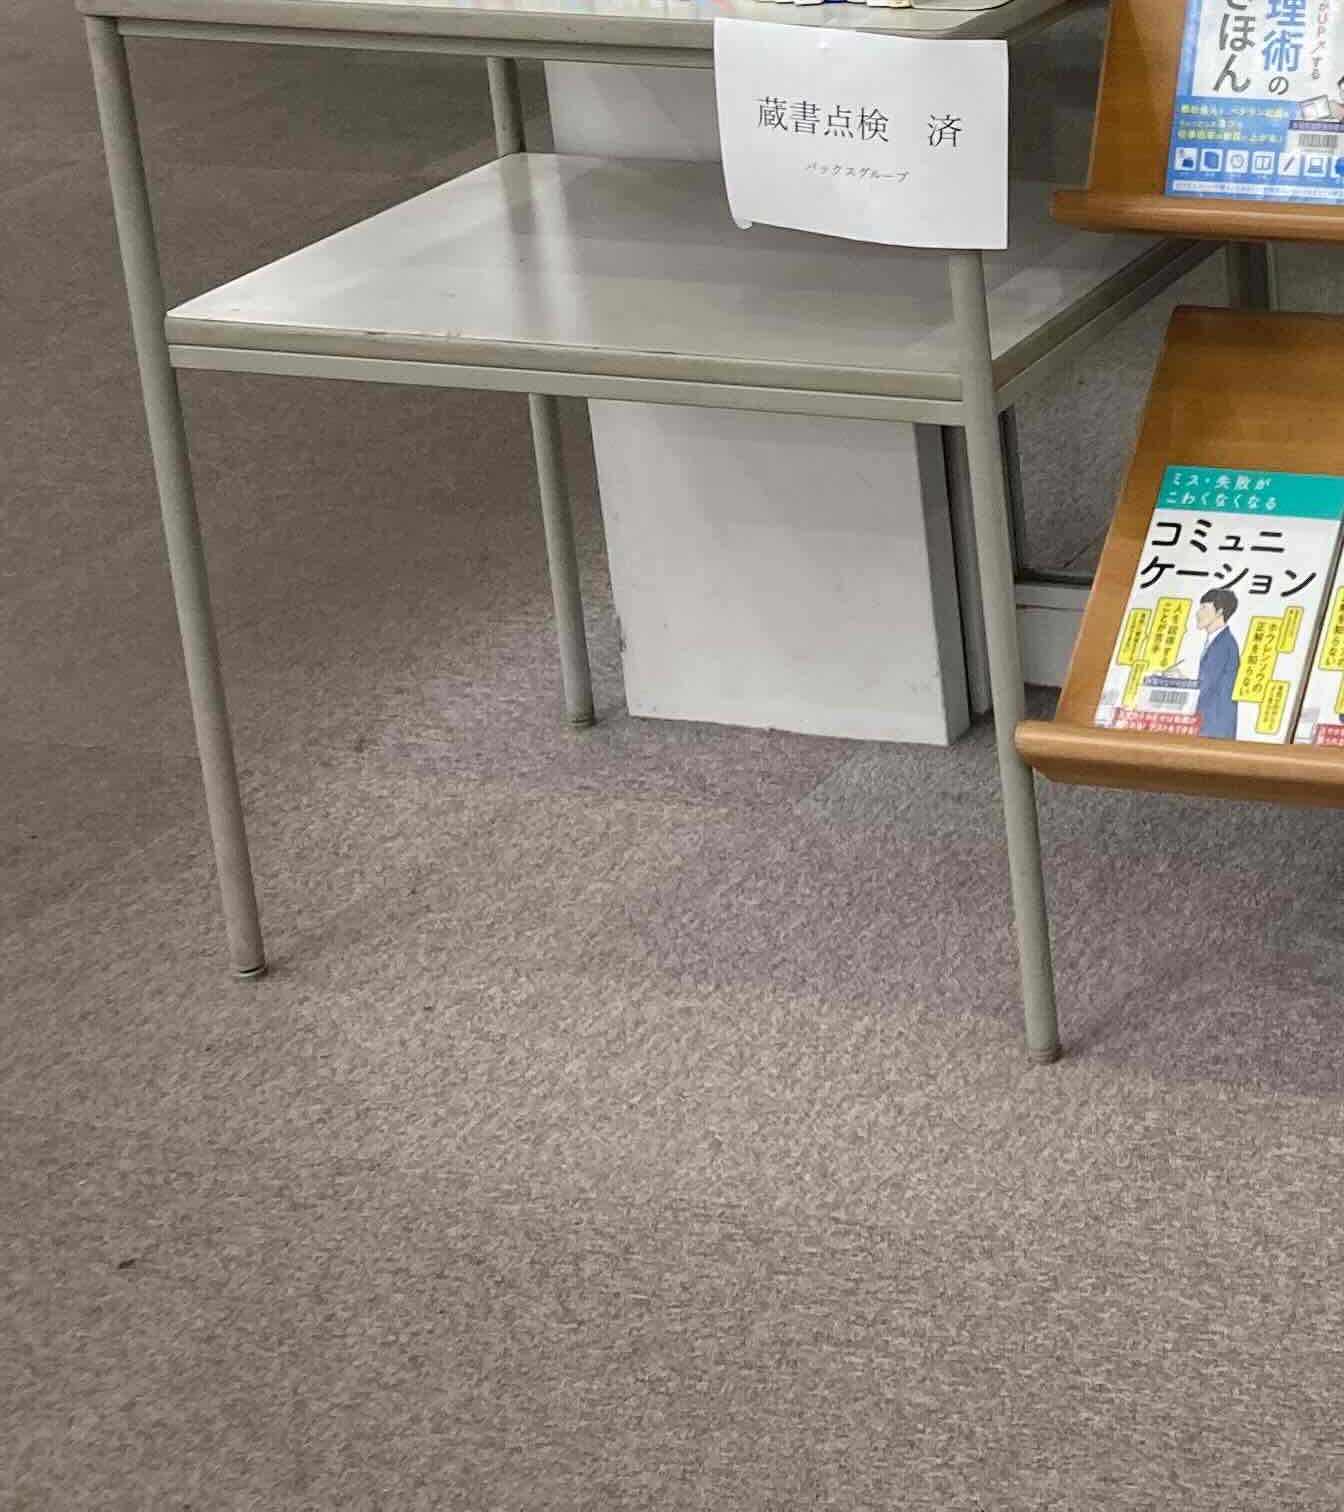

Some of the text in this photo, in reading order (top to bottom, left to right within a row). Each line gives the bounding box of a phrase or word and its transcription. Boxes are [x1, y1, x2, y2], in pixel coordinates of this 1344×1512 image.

[753, 95, 963, 148] 蔵書点検 済
[1172, 472, 1272, 490] ミス・失敗が
[1165, 491, 1278, 511] こわくなくなる
[1151, 519, 1286, 553] コミュニ
[1139, 555, 1318, 598] ケーション
